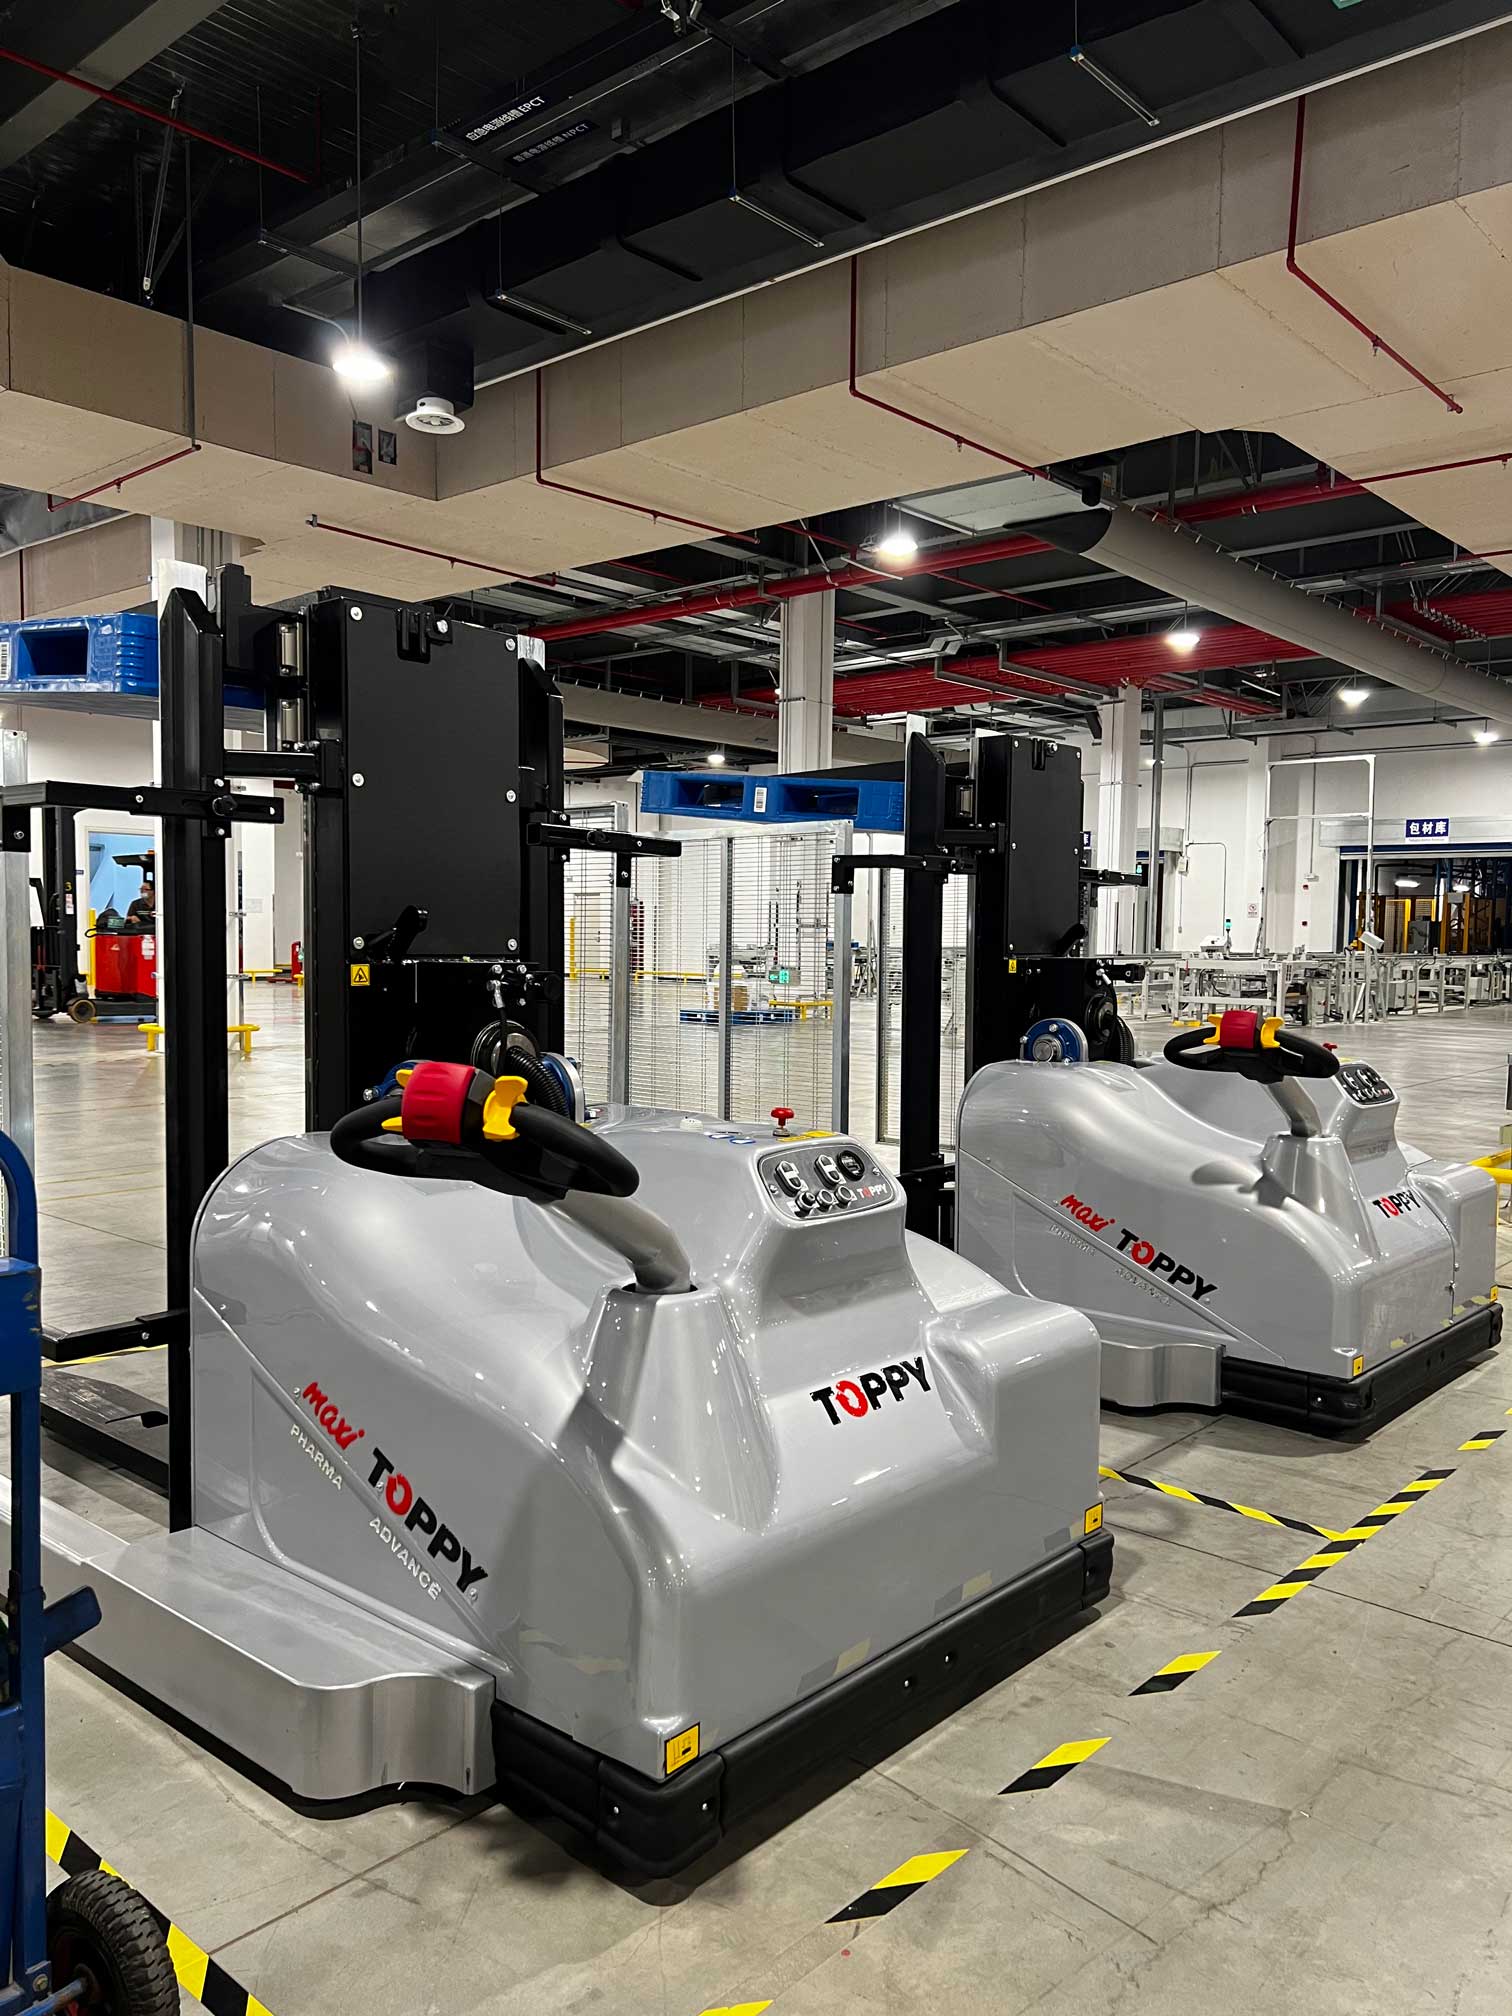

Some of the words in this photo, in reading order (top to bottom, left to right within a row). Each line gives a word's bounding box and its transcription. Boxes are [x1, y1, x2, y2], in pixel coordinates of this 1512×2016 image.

[518, 96, 545, 113] EPCT
[562, 123, 589, 140] NPCT
[1409, 820, 1447, 835] 包材库
[856, 1183, 888, 1199] TOPPY
[1372, 1189, 1421, 1219] TOPPY
[1060, 1194, 1116, 1232] maxi
[1116, 1228, 1218, 1301] TOPPY
[809, 1356, 932, 1426] TOPPY
[290, 1423, 343, 1491] PHARMA
[302, 1381, 365, 1450] maxi
[367, 1447, 489, 1594] TOPPY
[368, 1516, 442, 1601] ADVANCE
